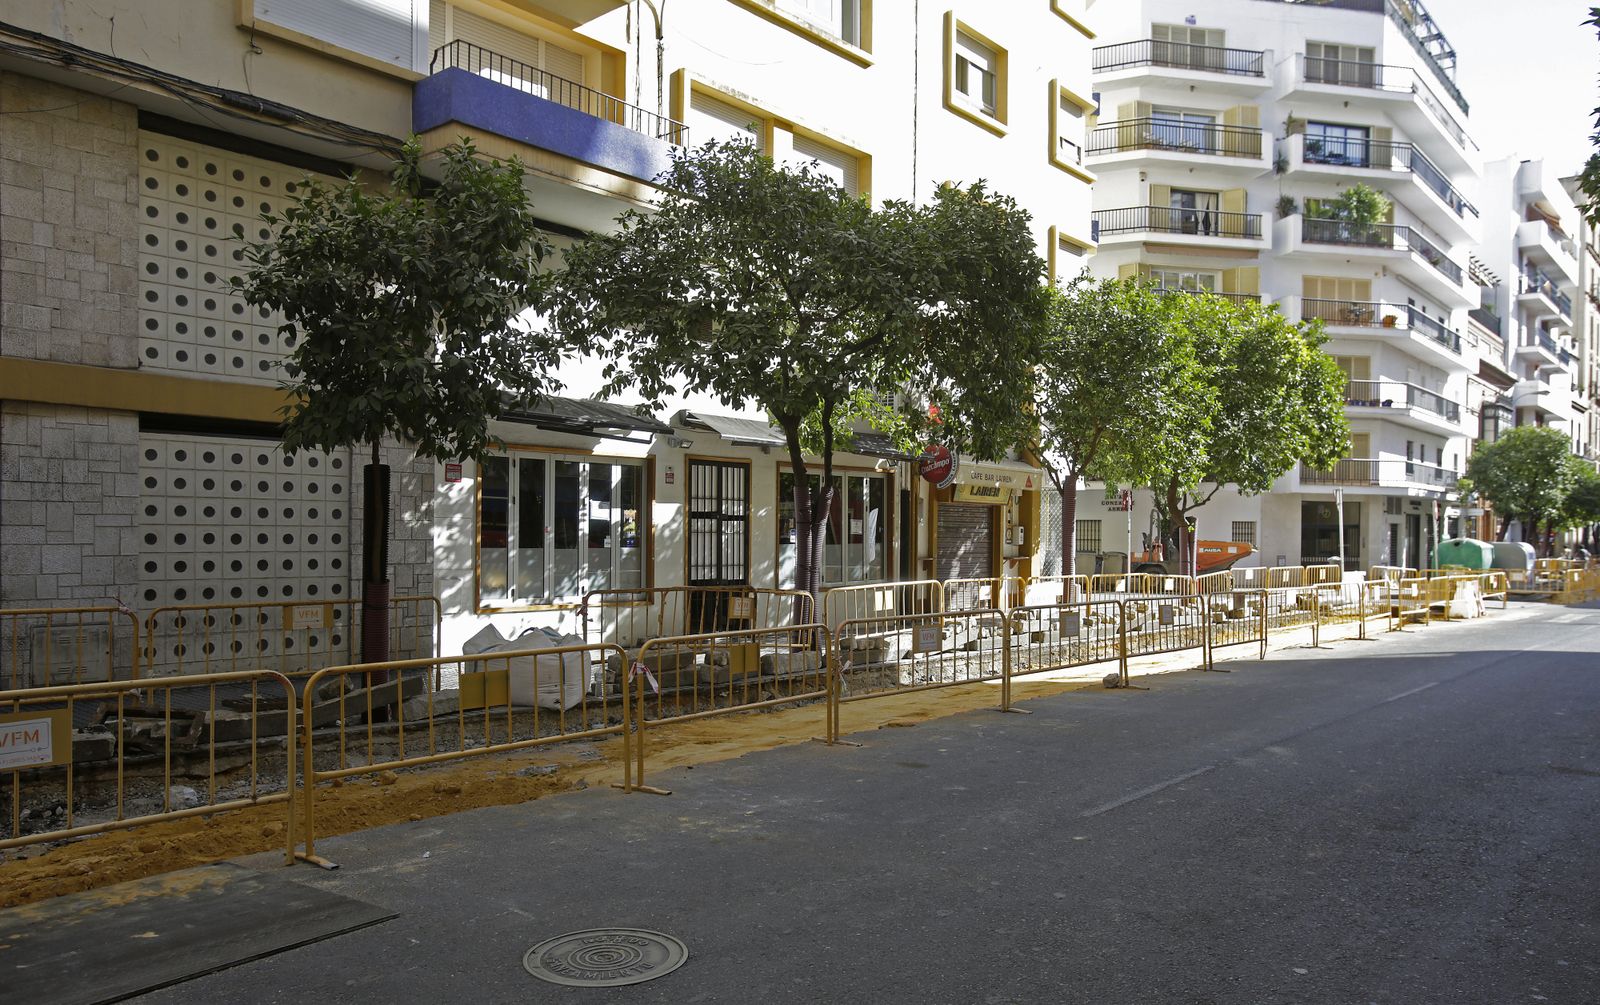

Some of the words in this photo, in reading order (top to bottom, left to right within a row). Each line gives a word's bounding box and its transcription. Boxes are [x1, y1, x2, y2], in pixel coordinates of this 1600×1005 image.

[984, 473, 994, 481] BAR
[970, 485, 1001, 497] LAIREN
[298, 610, 319, 618] VFM
